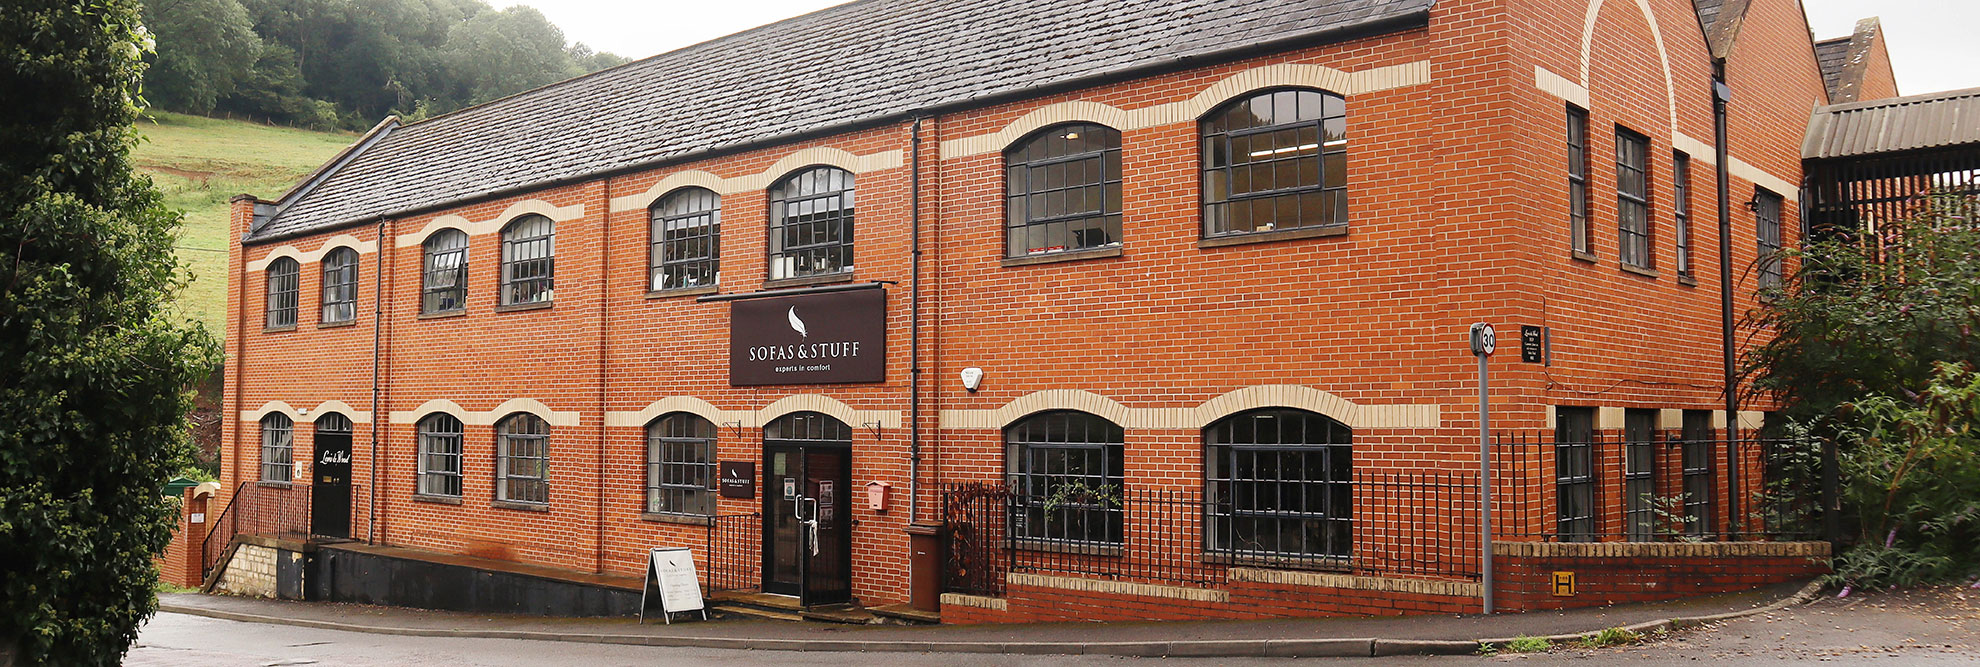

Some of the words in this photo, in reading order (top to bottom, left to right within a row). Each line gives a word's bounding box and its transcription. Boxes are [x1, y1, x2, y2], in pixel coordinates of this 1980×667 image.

[1483, 333, 1494, 348] 30
[749, 344, 794, 361] SOFAS
[797, 343, 808, 359] &
[810, 341, 860, 358] STUFF
[775, 365, 798, 374] experts
[806, 364, 831, 372] comfort
[1555, 574, 1572, 594] H
